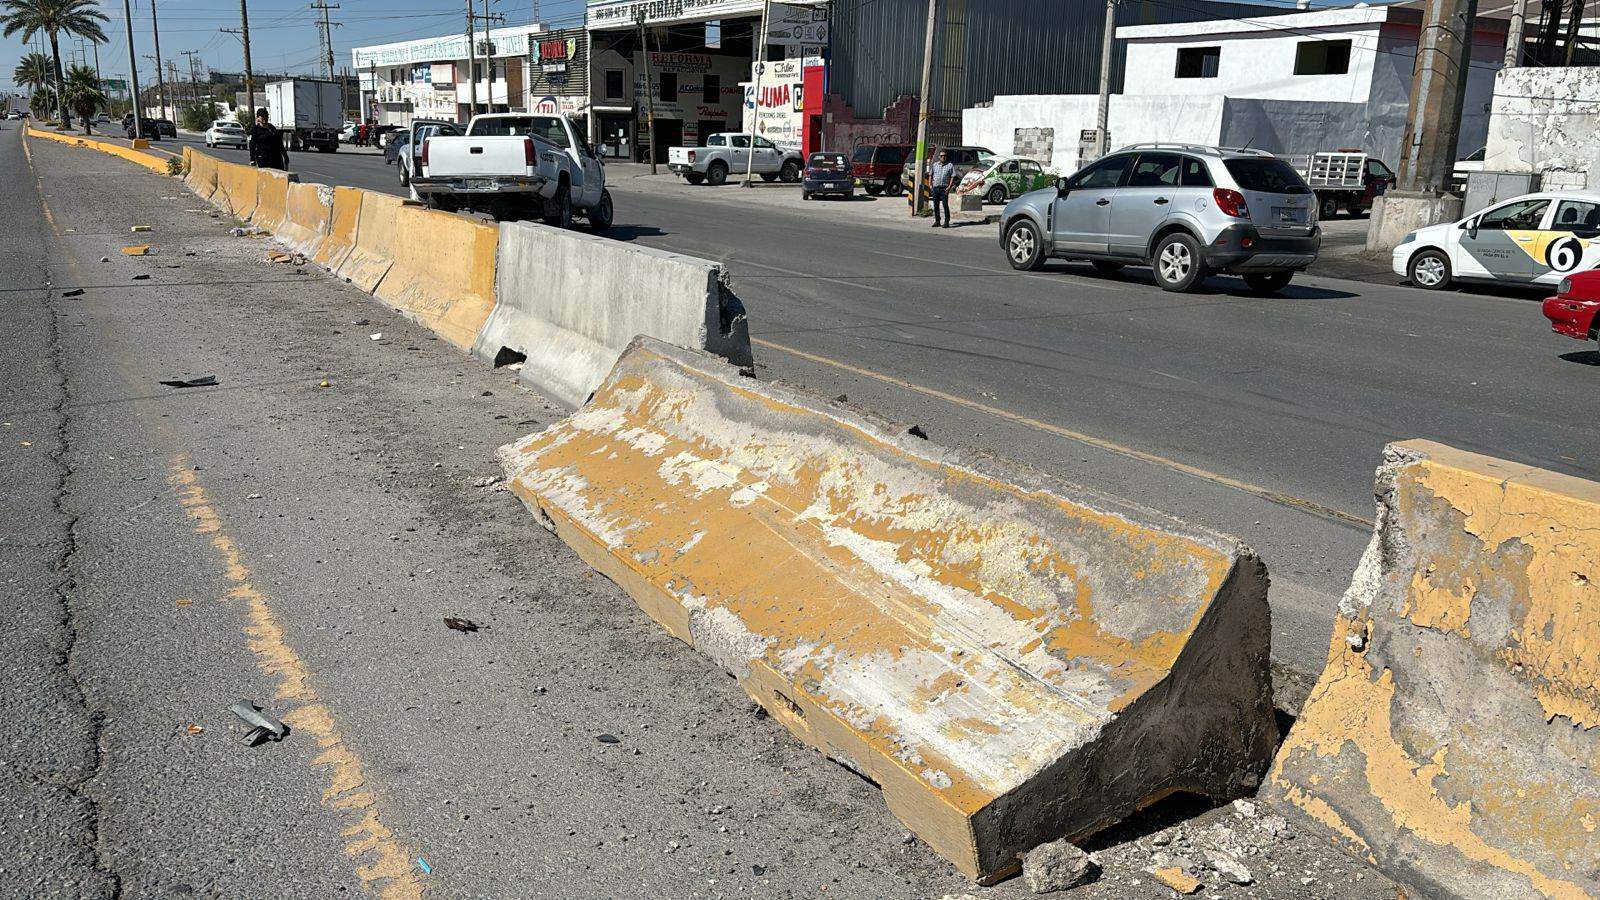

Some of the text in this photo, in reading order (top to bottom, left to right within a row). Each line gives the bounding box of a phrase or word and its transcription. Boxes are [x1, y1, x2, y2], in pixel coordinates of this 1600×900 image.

[630, 0, 684, 21] REFORMA
[652, 53, 712, 64] REFORMA
[758, 84, 790, 108] JUMA
[1549, 237, 1577, 271] 6
